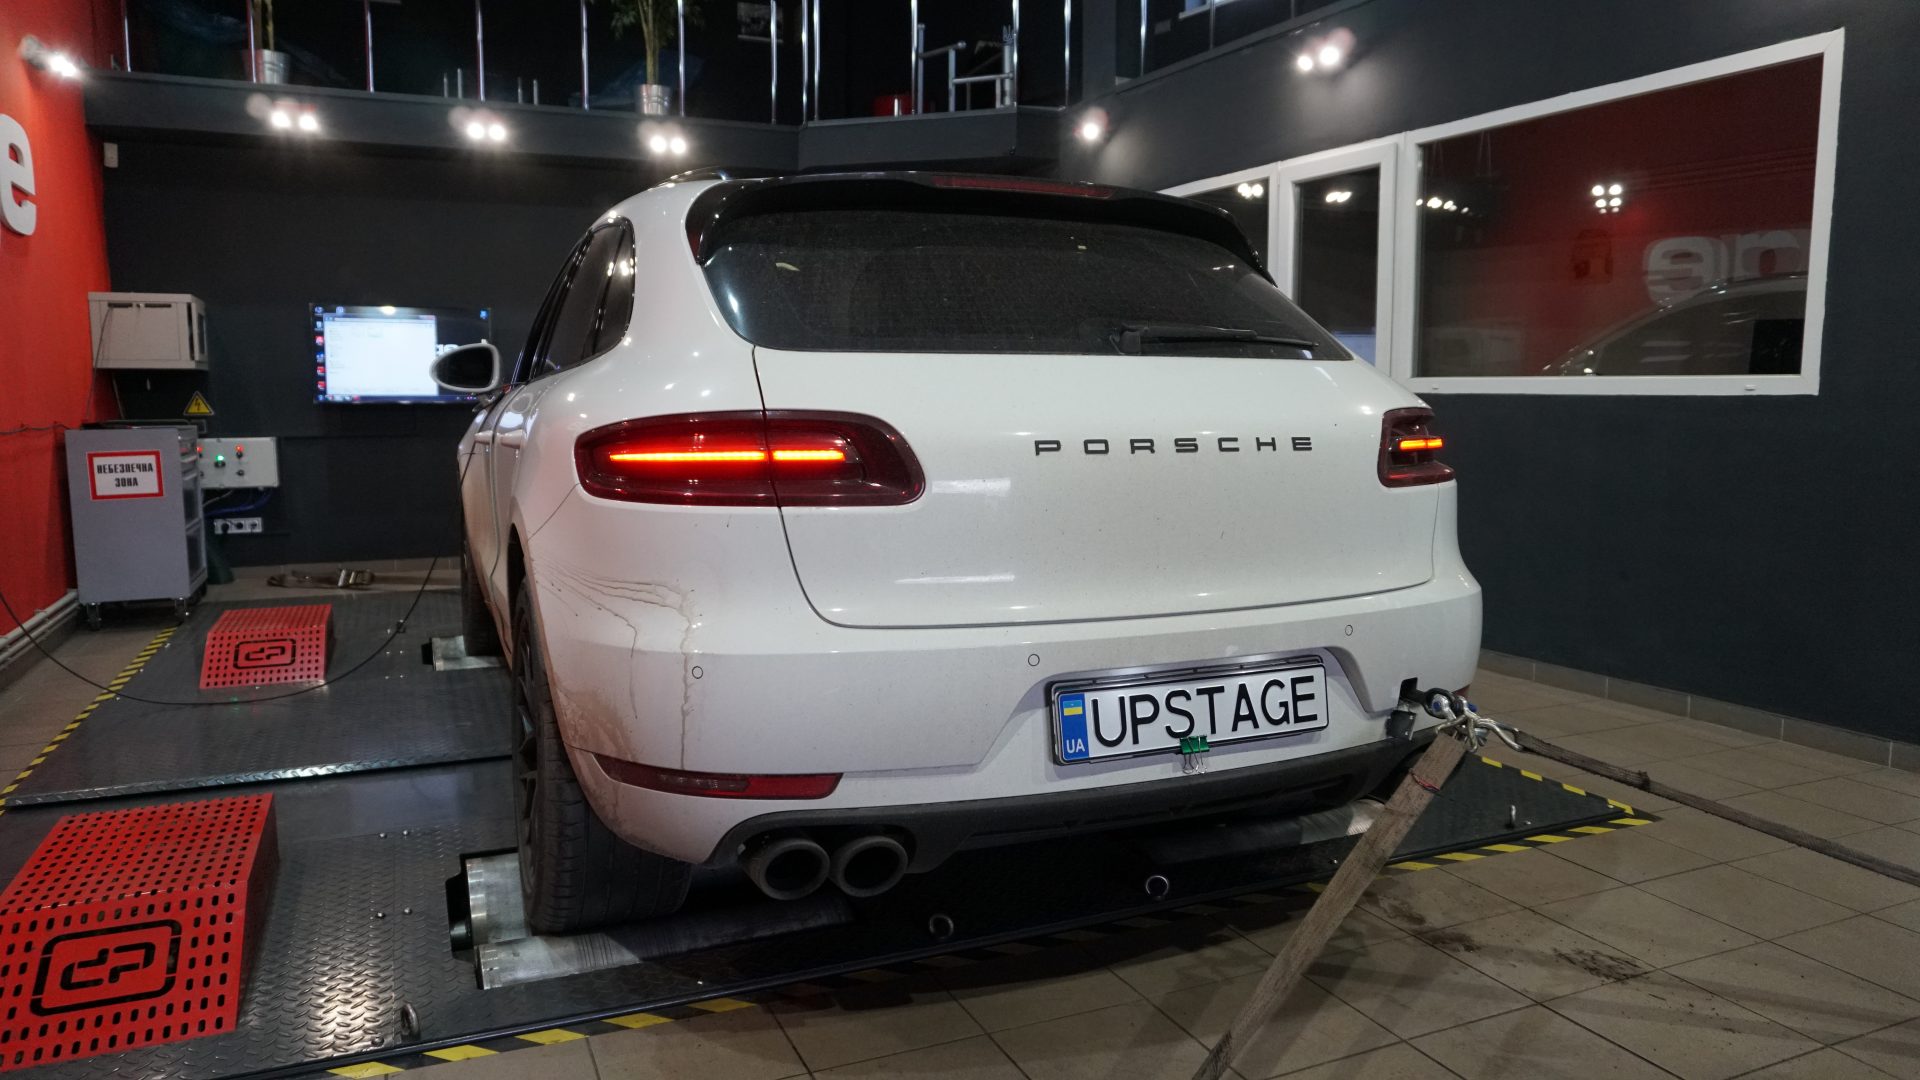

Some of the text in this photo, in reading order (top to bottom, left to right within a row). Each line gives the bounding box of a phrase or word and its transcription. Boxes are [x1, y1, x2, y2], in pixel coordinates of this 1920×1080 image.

[1034, 437, 1313, 456] PORSCHE
[97, 463, 153, 474] НЕБЕЗПЕЧНА
[115, 477, 139, 488] ЗОНА
[1091, 675, 1318, 748] UPSTAGE
[1066, 738, 1085, 754] UA
